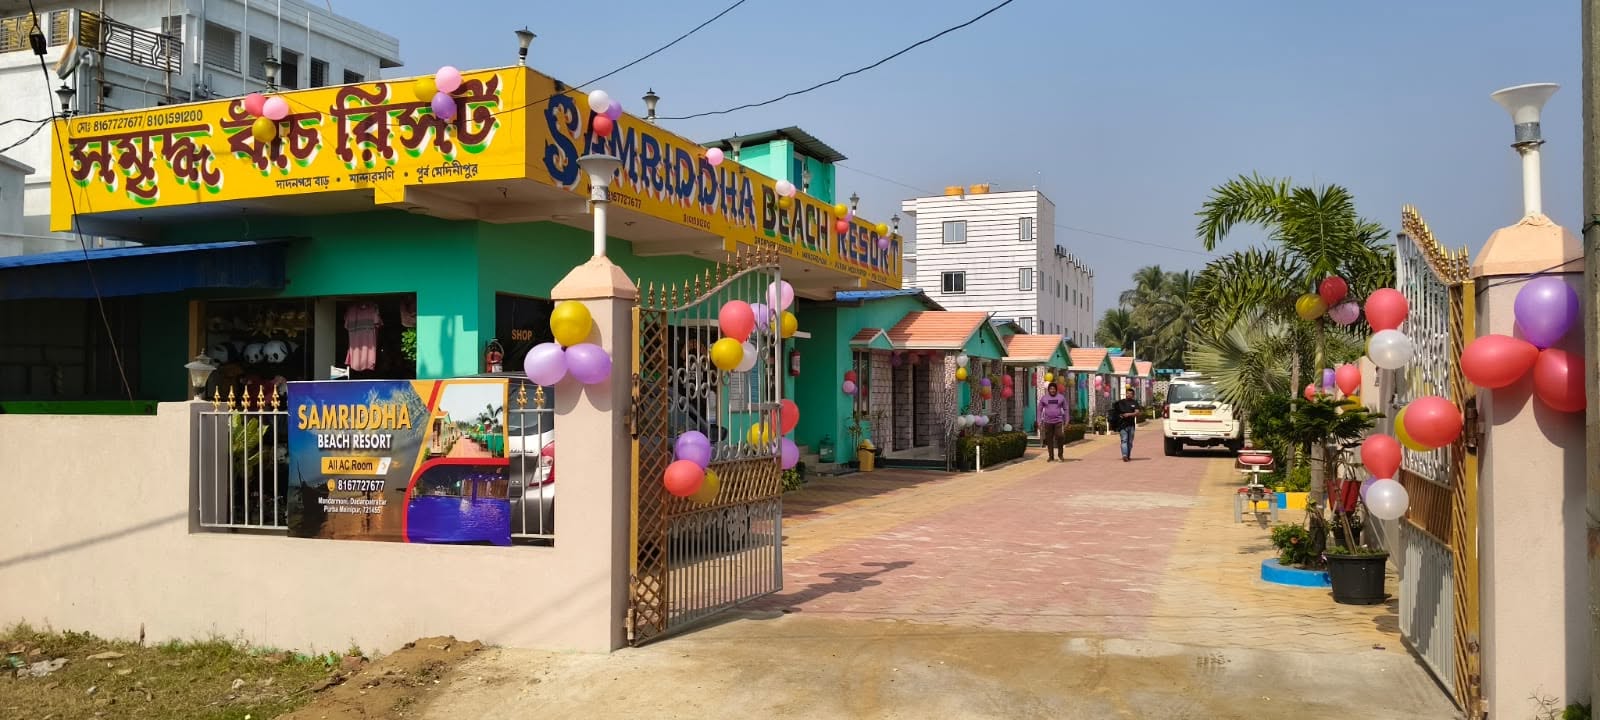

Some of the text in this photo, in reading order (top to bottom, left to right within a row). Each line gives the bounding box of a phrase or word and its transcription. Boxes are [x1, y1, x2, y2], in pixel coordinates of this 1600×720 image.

[69, 124, 222, 202] সমৃদ্ধ
[762, 184, 829, 254] BEACH
[837, 218, 899, 276] RESORT
[511, 329, 533, 341] SHOP
[298, 403, 412, 430] SAMRIDDHA
[317, 433, 392, 449] BEACH RESORT
[328, 460, 373, 471] All AC Room
[337, 480, 385, 491] 8167727677
[323, 505, 338, 513] Purba
